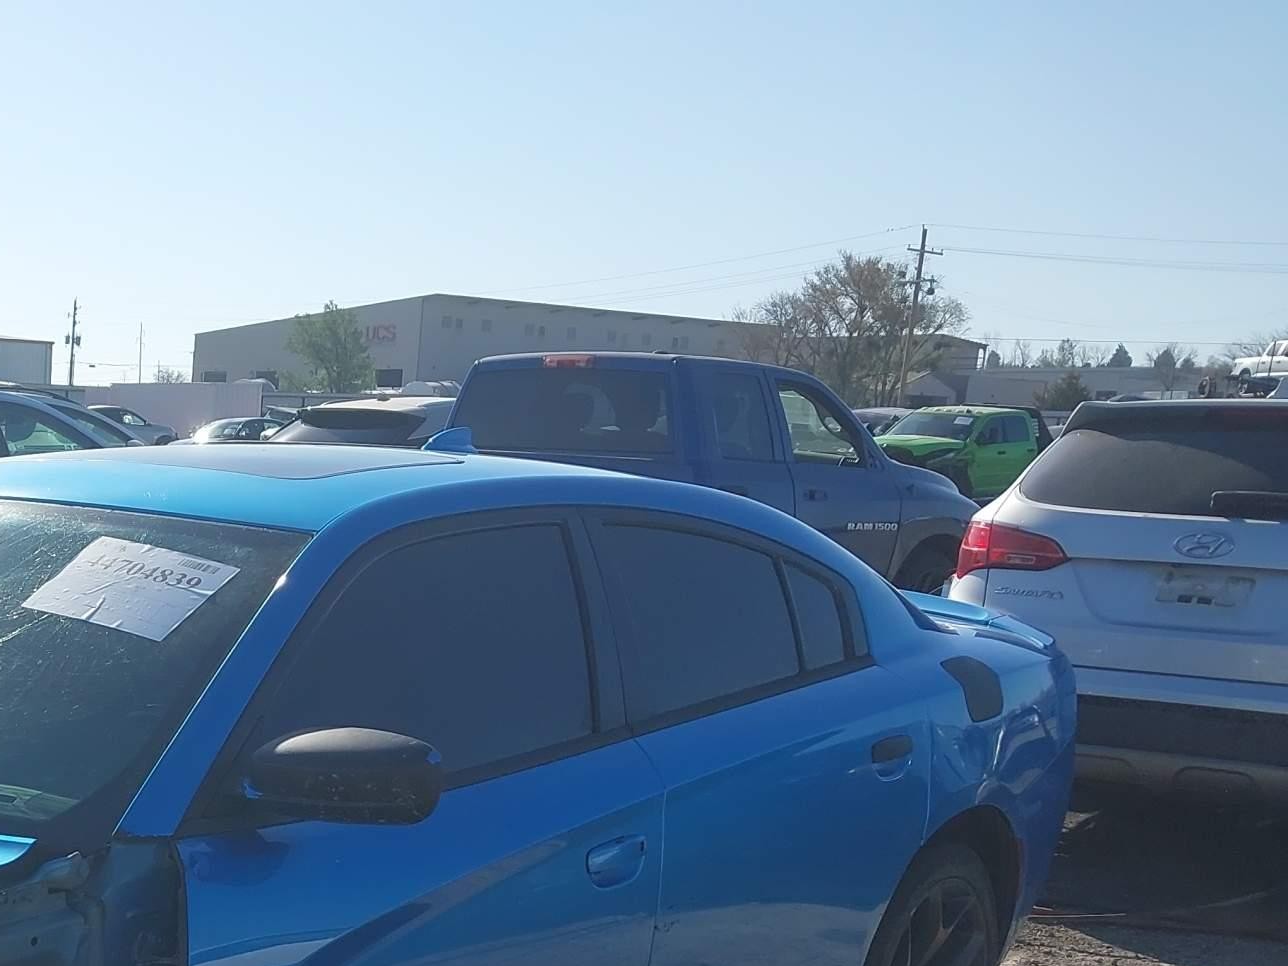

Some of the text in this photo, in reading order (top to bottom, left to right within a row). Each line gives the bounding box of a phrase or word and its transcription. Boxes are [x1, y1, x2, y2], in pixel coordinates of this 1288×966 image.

[847, 521, 899, 531] RAM 1500
[88, 554, 202, 589] 44704839
